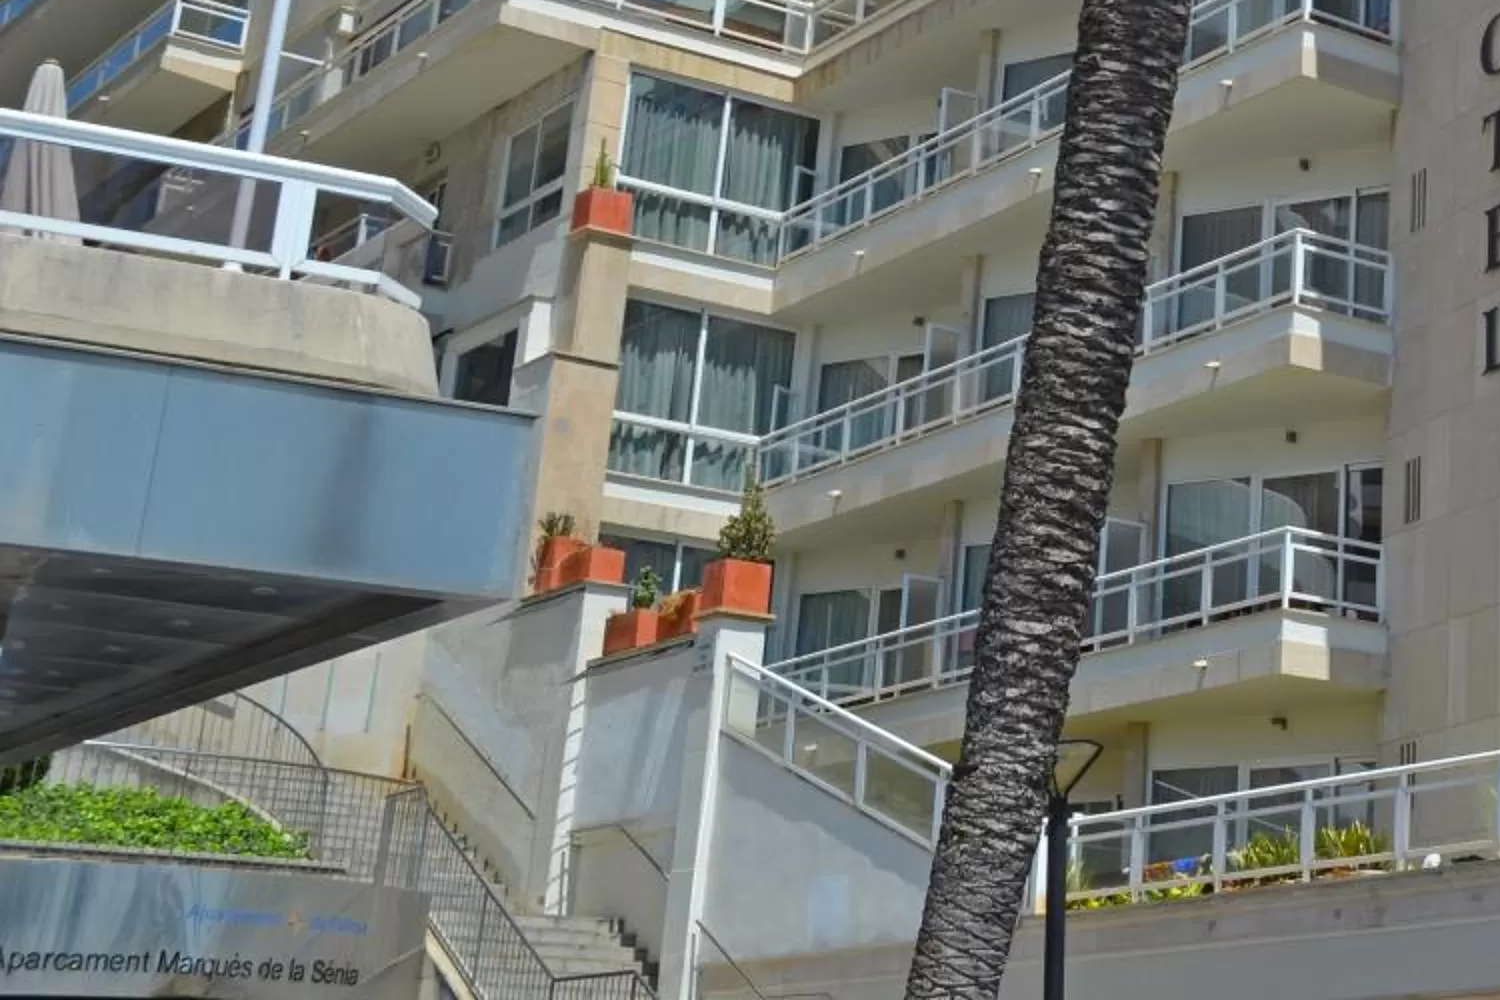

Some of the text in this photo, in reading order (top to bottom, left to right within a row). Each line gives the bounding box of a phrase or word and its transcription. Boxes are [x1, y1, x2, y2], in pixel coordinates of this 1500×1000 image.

[0, 945, 149, 976] parcament
[257, 957, 283, 981] de
[287, 957, 305, 982] la
